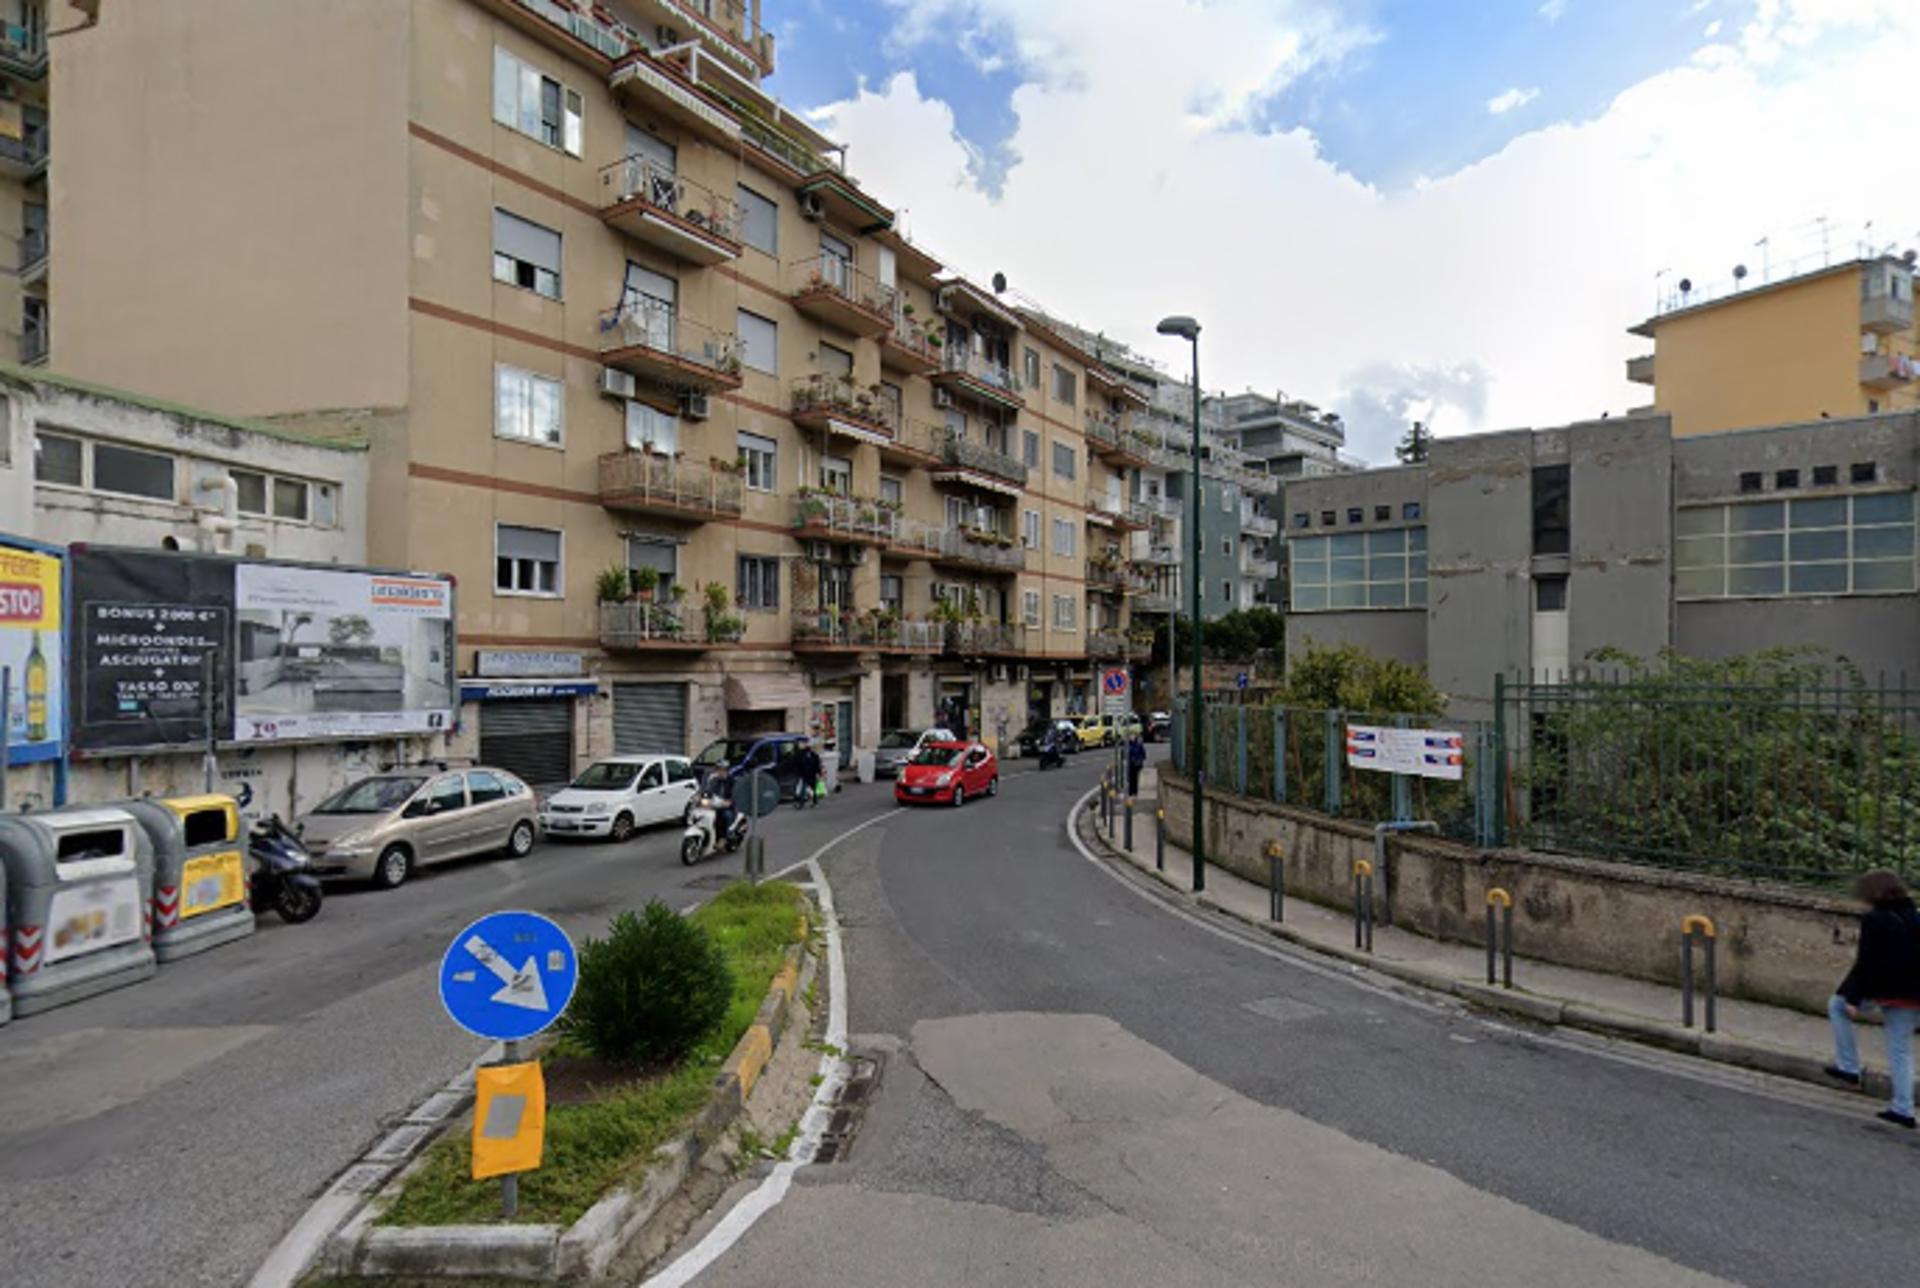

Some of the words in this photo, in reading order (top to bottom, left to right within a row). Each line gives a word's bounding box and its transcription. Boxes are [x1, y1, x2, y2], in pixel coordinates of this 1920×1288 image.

[97, 607, 155, 620] BONUS
[99, 654, 202, 666] ASCIUGATRI
[116, 681, 168, 692] TASSO
